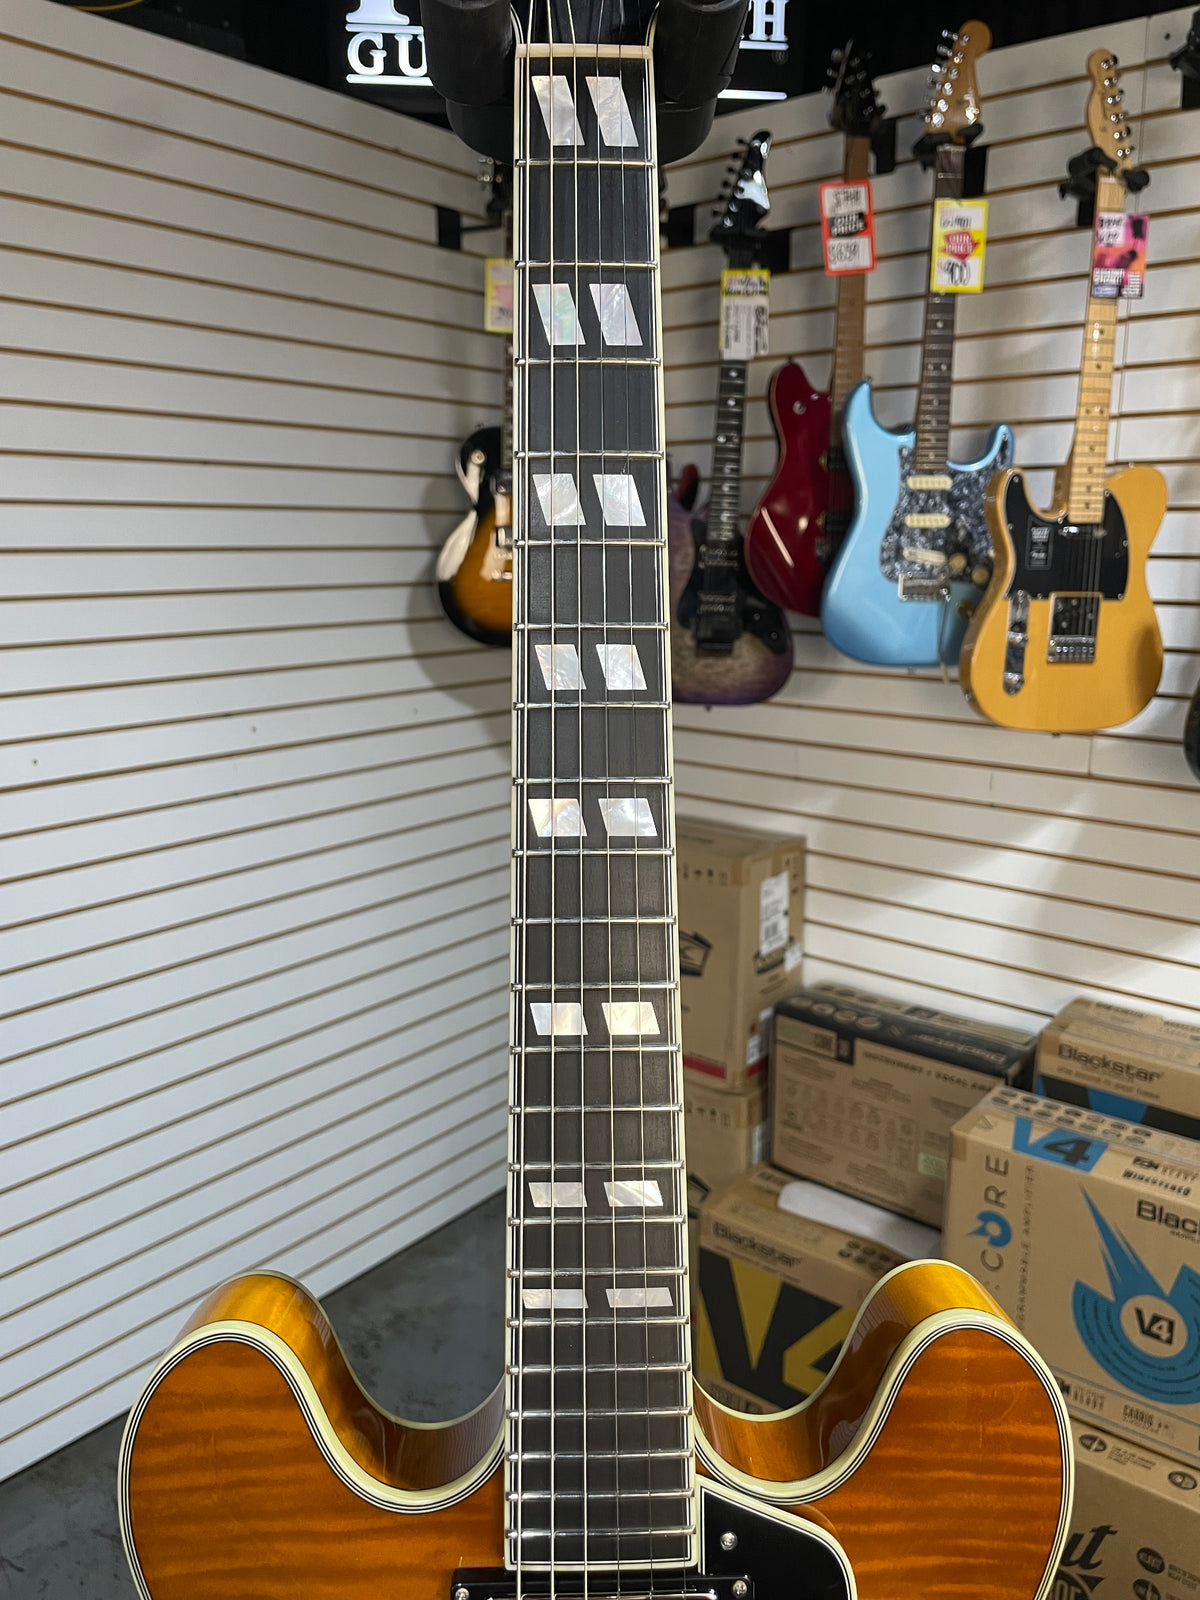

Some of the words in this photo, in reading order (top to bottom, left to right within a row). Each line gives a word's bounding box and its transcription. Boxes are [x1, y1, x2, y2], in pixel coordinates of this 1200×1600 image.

[1058, 1043, 1161, 1083] Blackstar
[1136, 1199, 1200, 1236] Blac
[1134, 1307, 1175, 1346] V4
